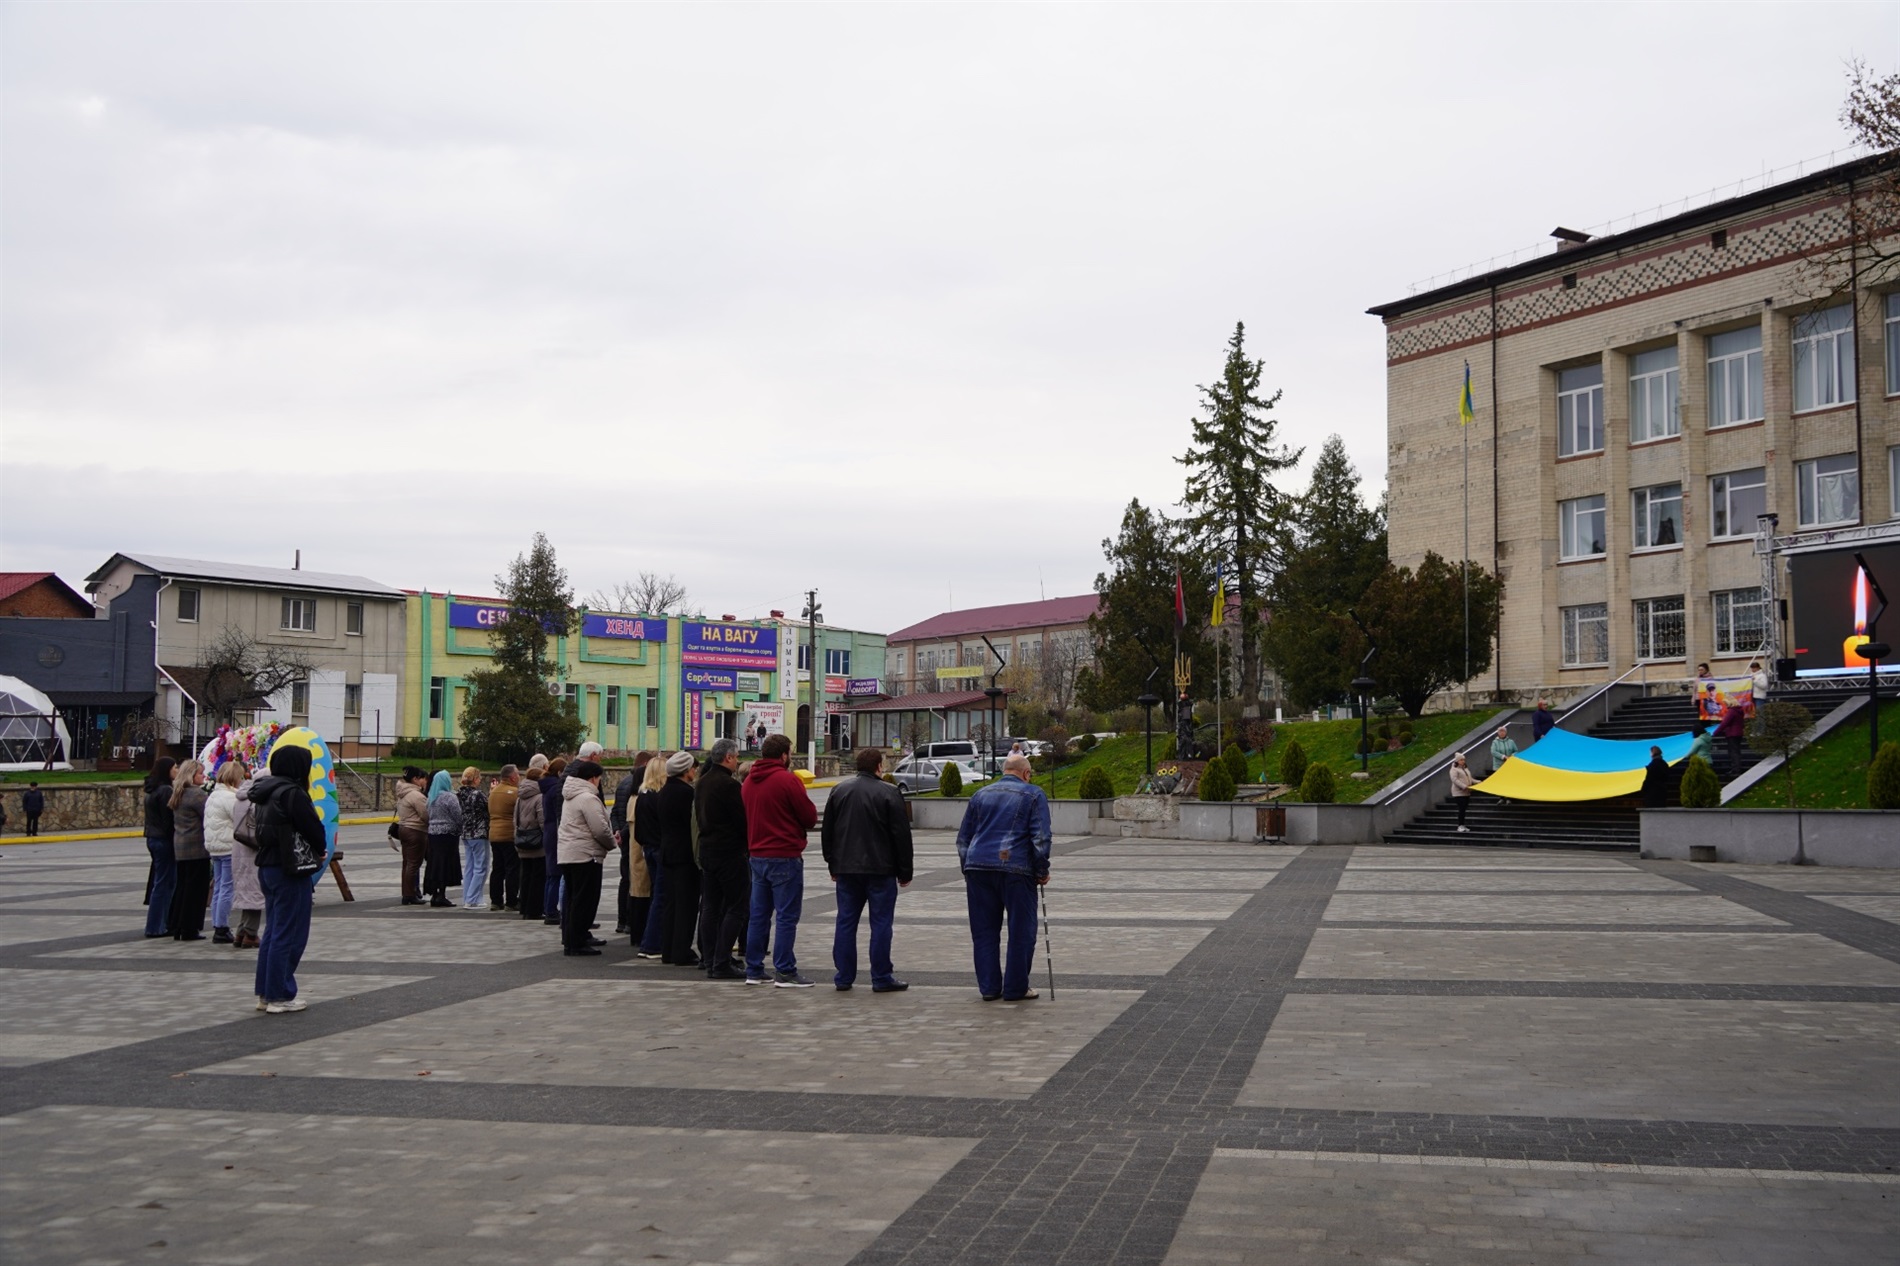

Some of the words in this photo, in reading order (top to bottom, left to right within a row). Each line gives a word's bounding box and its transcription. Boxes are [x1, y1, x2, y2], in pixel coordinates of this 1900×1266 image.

[606, 618, 644, 639] ХЕНД
[702, 626, 721, 642] НА
[725, 628, 758, 644] ВАГУ
[785, 628, 793, 698] ЛОМБАРД
[760, 710, 782, 719] гроші?
